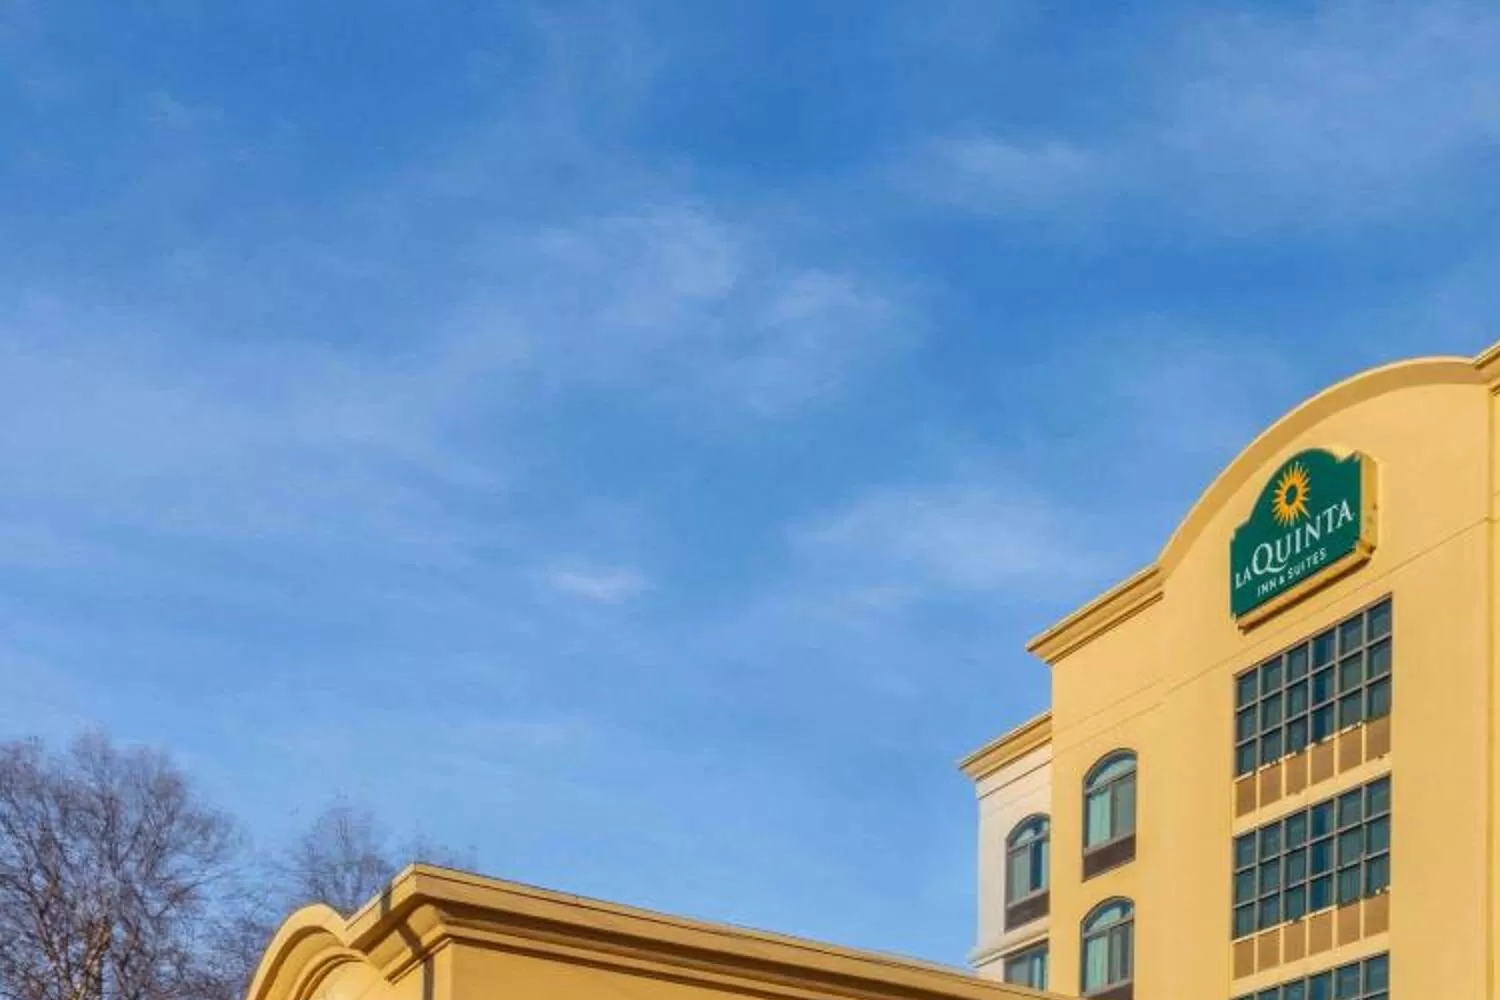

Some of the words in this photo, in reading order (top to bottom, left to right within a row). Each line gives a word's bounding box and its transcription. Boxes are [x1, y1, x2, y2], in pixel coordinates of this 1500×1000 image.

[1234, 567, 1251, 589] LA
[1252, 498, 1354, 575] QUINTA
[1257, 581, 1277, 597] INN
[1279, 575, 1286, 586] &
[1287, 547, 1327, 579] SUITES
